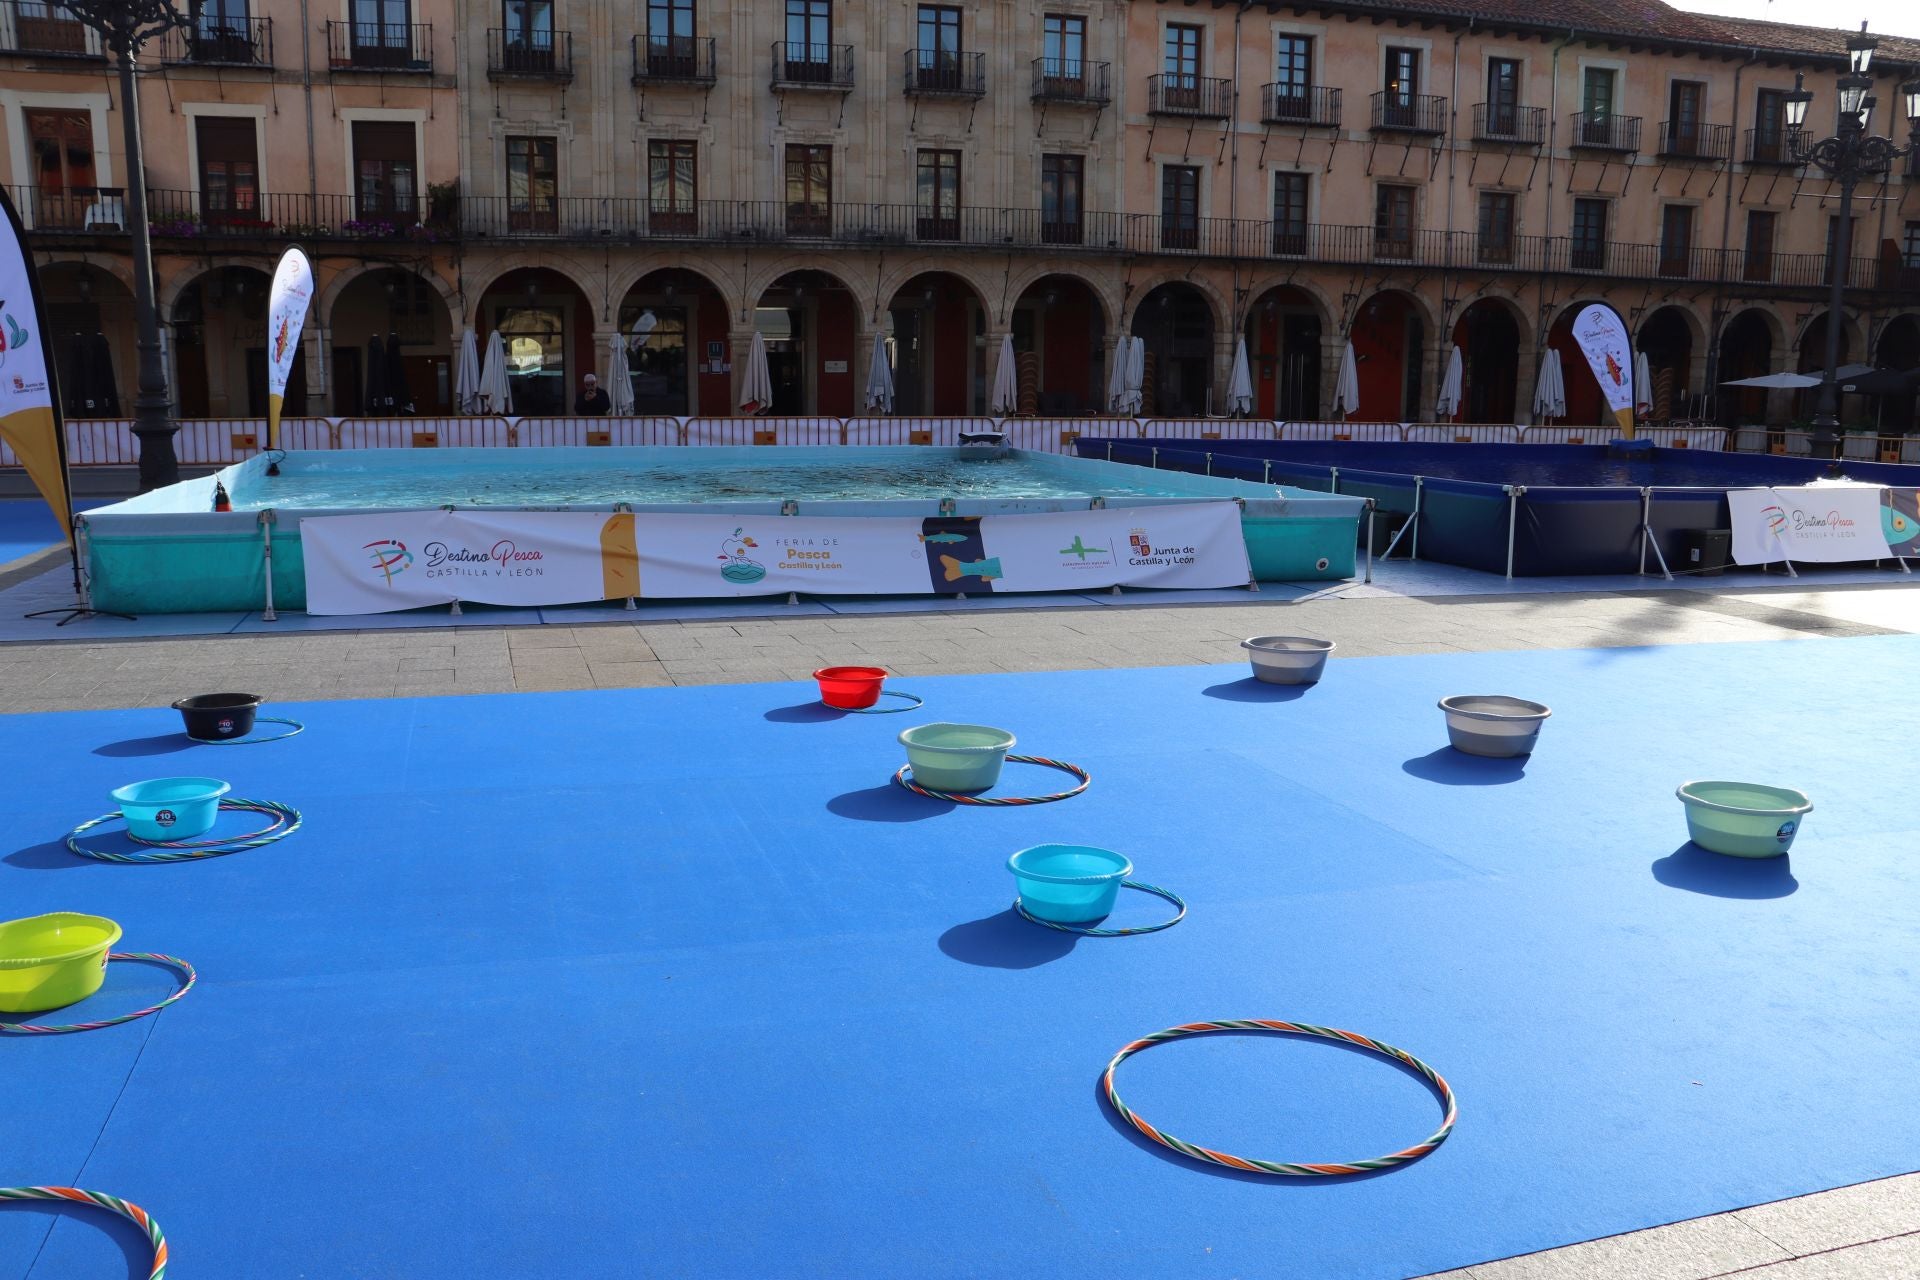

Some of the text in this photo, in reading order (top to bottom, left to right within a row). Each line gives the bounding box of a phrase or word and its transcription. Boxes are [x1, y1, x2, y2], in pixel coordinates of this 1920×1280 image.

[1792, 509, 1855, 531] Destino Pesca
[775, 538, 839, 546] FERIA DE
[424, 539, 543, 568] Destino Pesca
[786, 547, 832, 560] Pesca
[1153, 546, 1195, 556] Junta de
[778, 561, 842, 571] Castilla y León
[1128, 556, 1195, 566] Castilla y León
[426, 567, 544, 579] CASTILLA Y LEÓN
